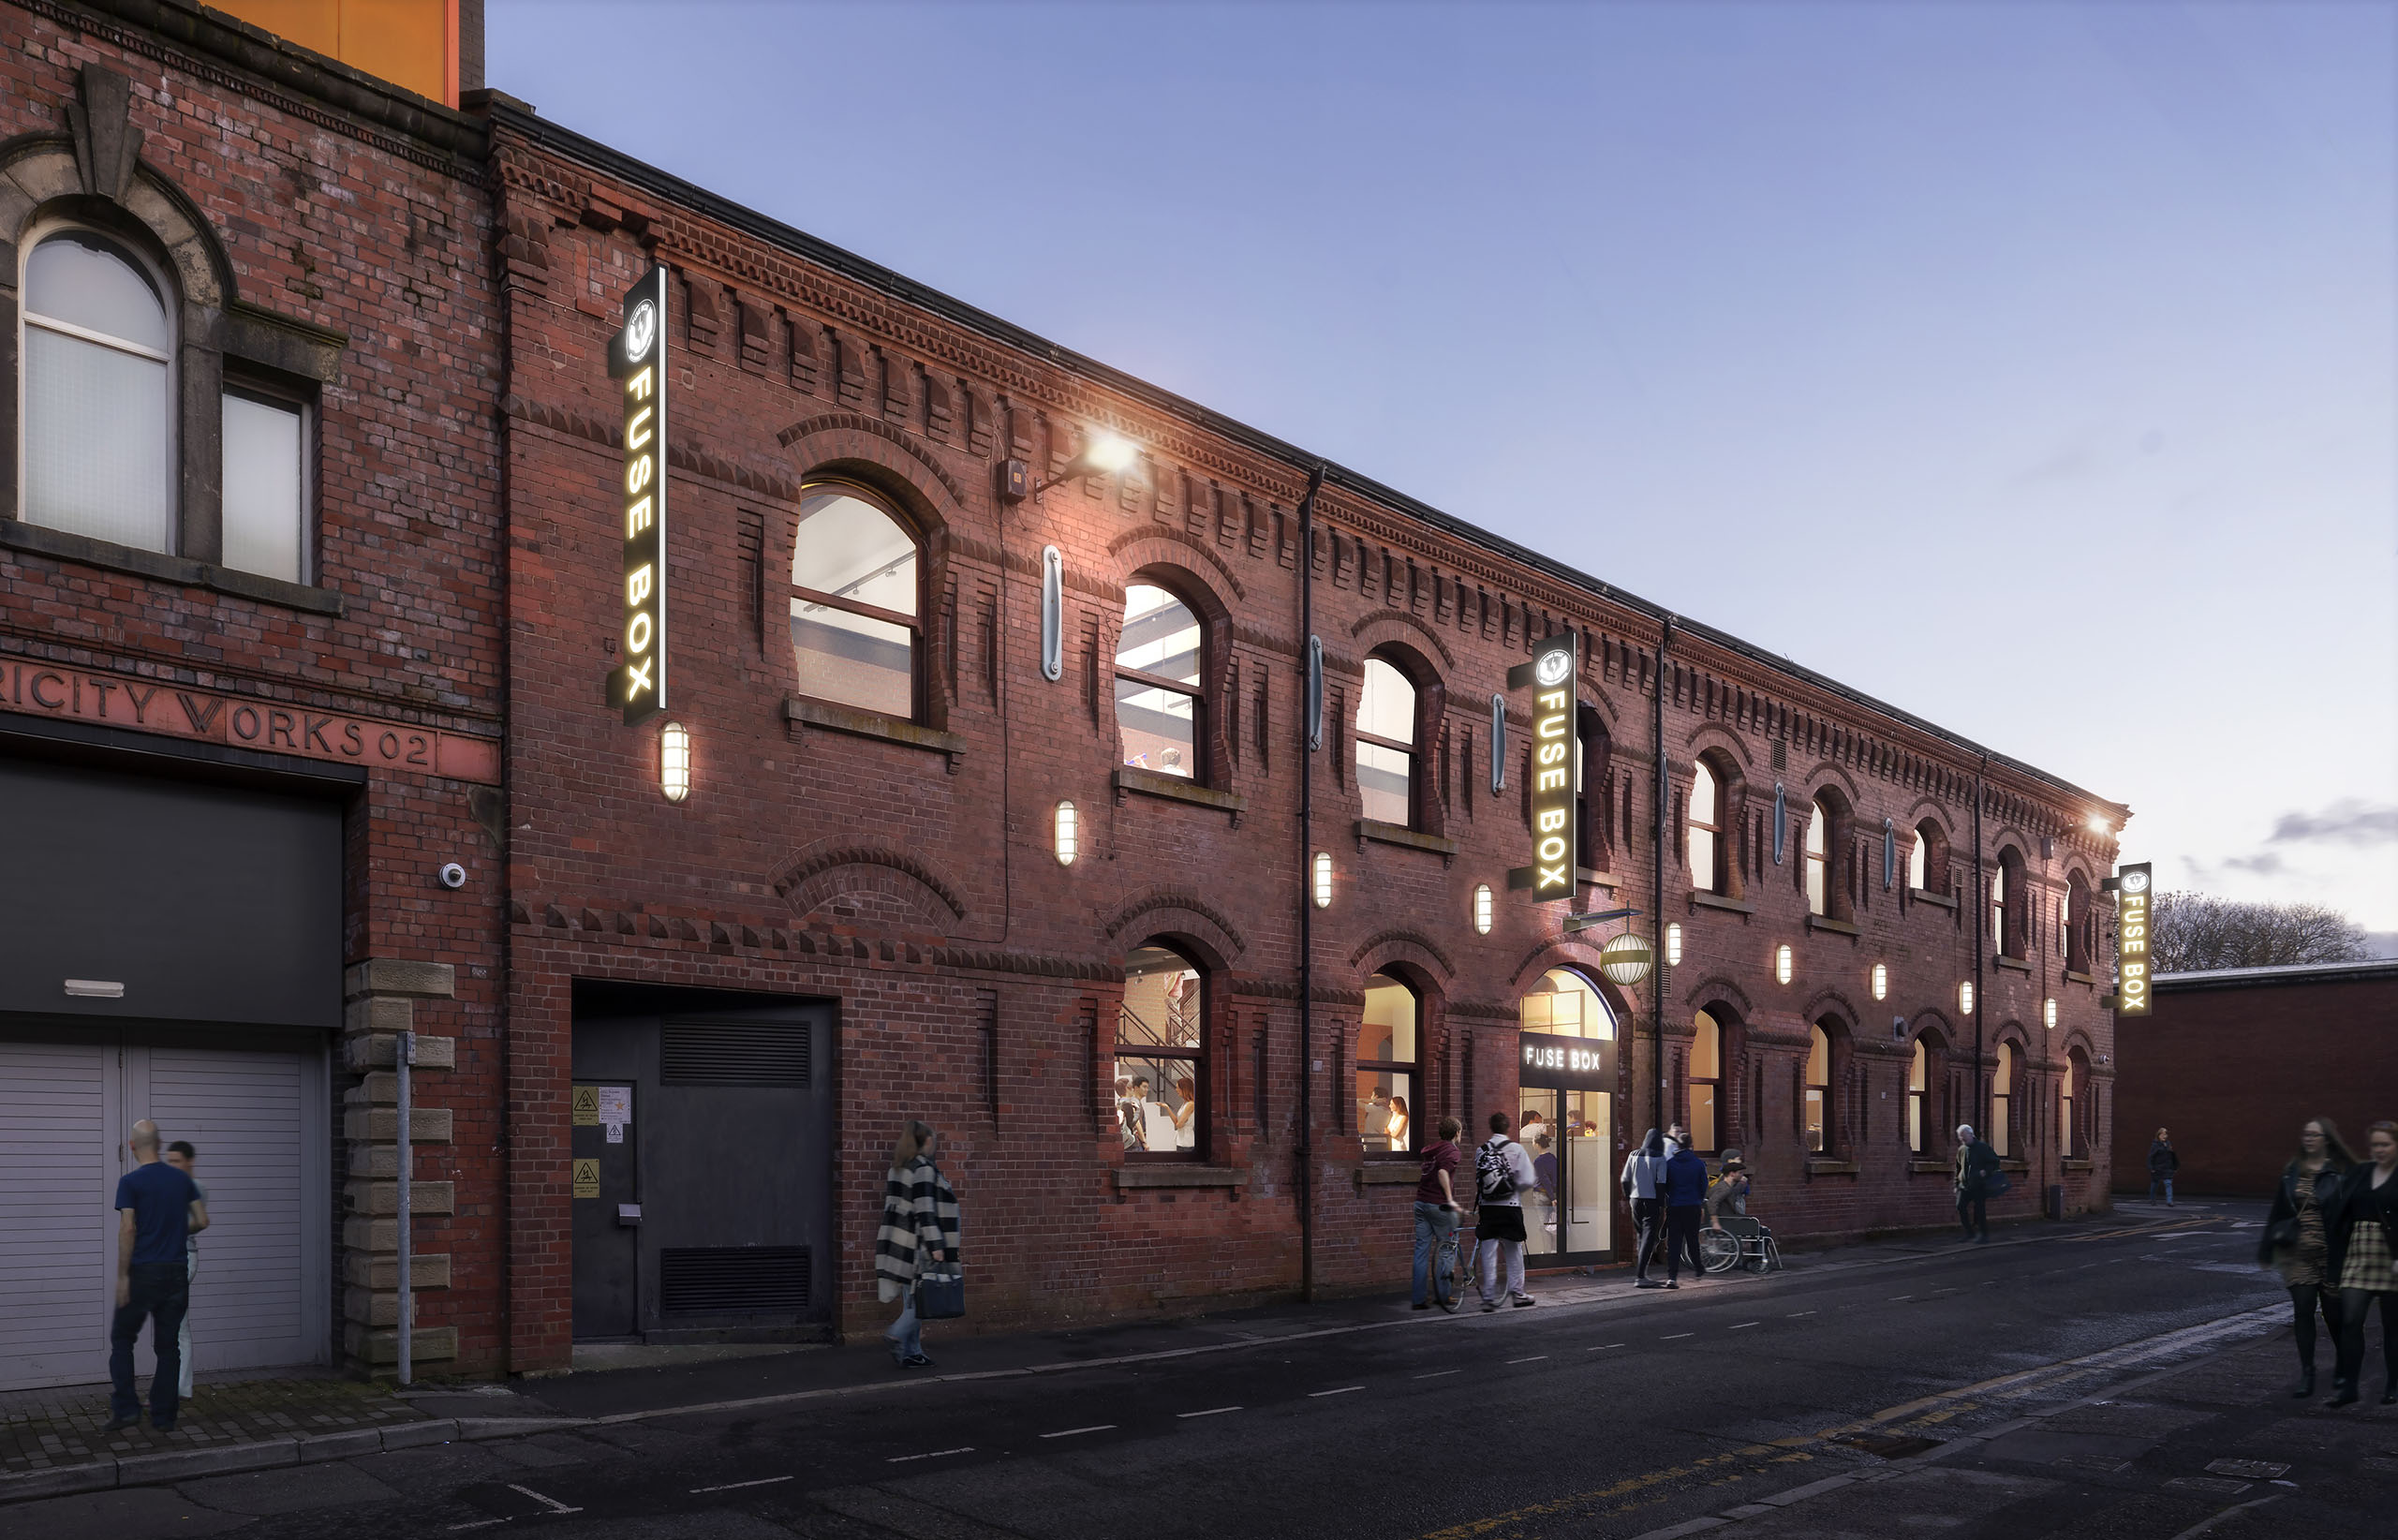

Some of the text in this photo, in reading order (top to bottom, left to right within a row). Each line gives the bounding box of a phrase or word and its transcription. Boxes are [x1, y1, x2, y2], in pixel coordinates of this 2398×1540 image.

[629, 366, 652, 540] FUSE
[629, 563, 652, 702] BOX
[176, 692, 364, 756] WORKS
[378, 731, 428, 765] 02
[1539, 690, 1566, 792] FUSE
[1539, 808, 1566, 889] BOX
[2124, 896, 2145, 954] FUSE
[2124, 963, 2145, 1011] BOX
[1526, 1047, 1600, 1071] FUSE BOX
